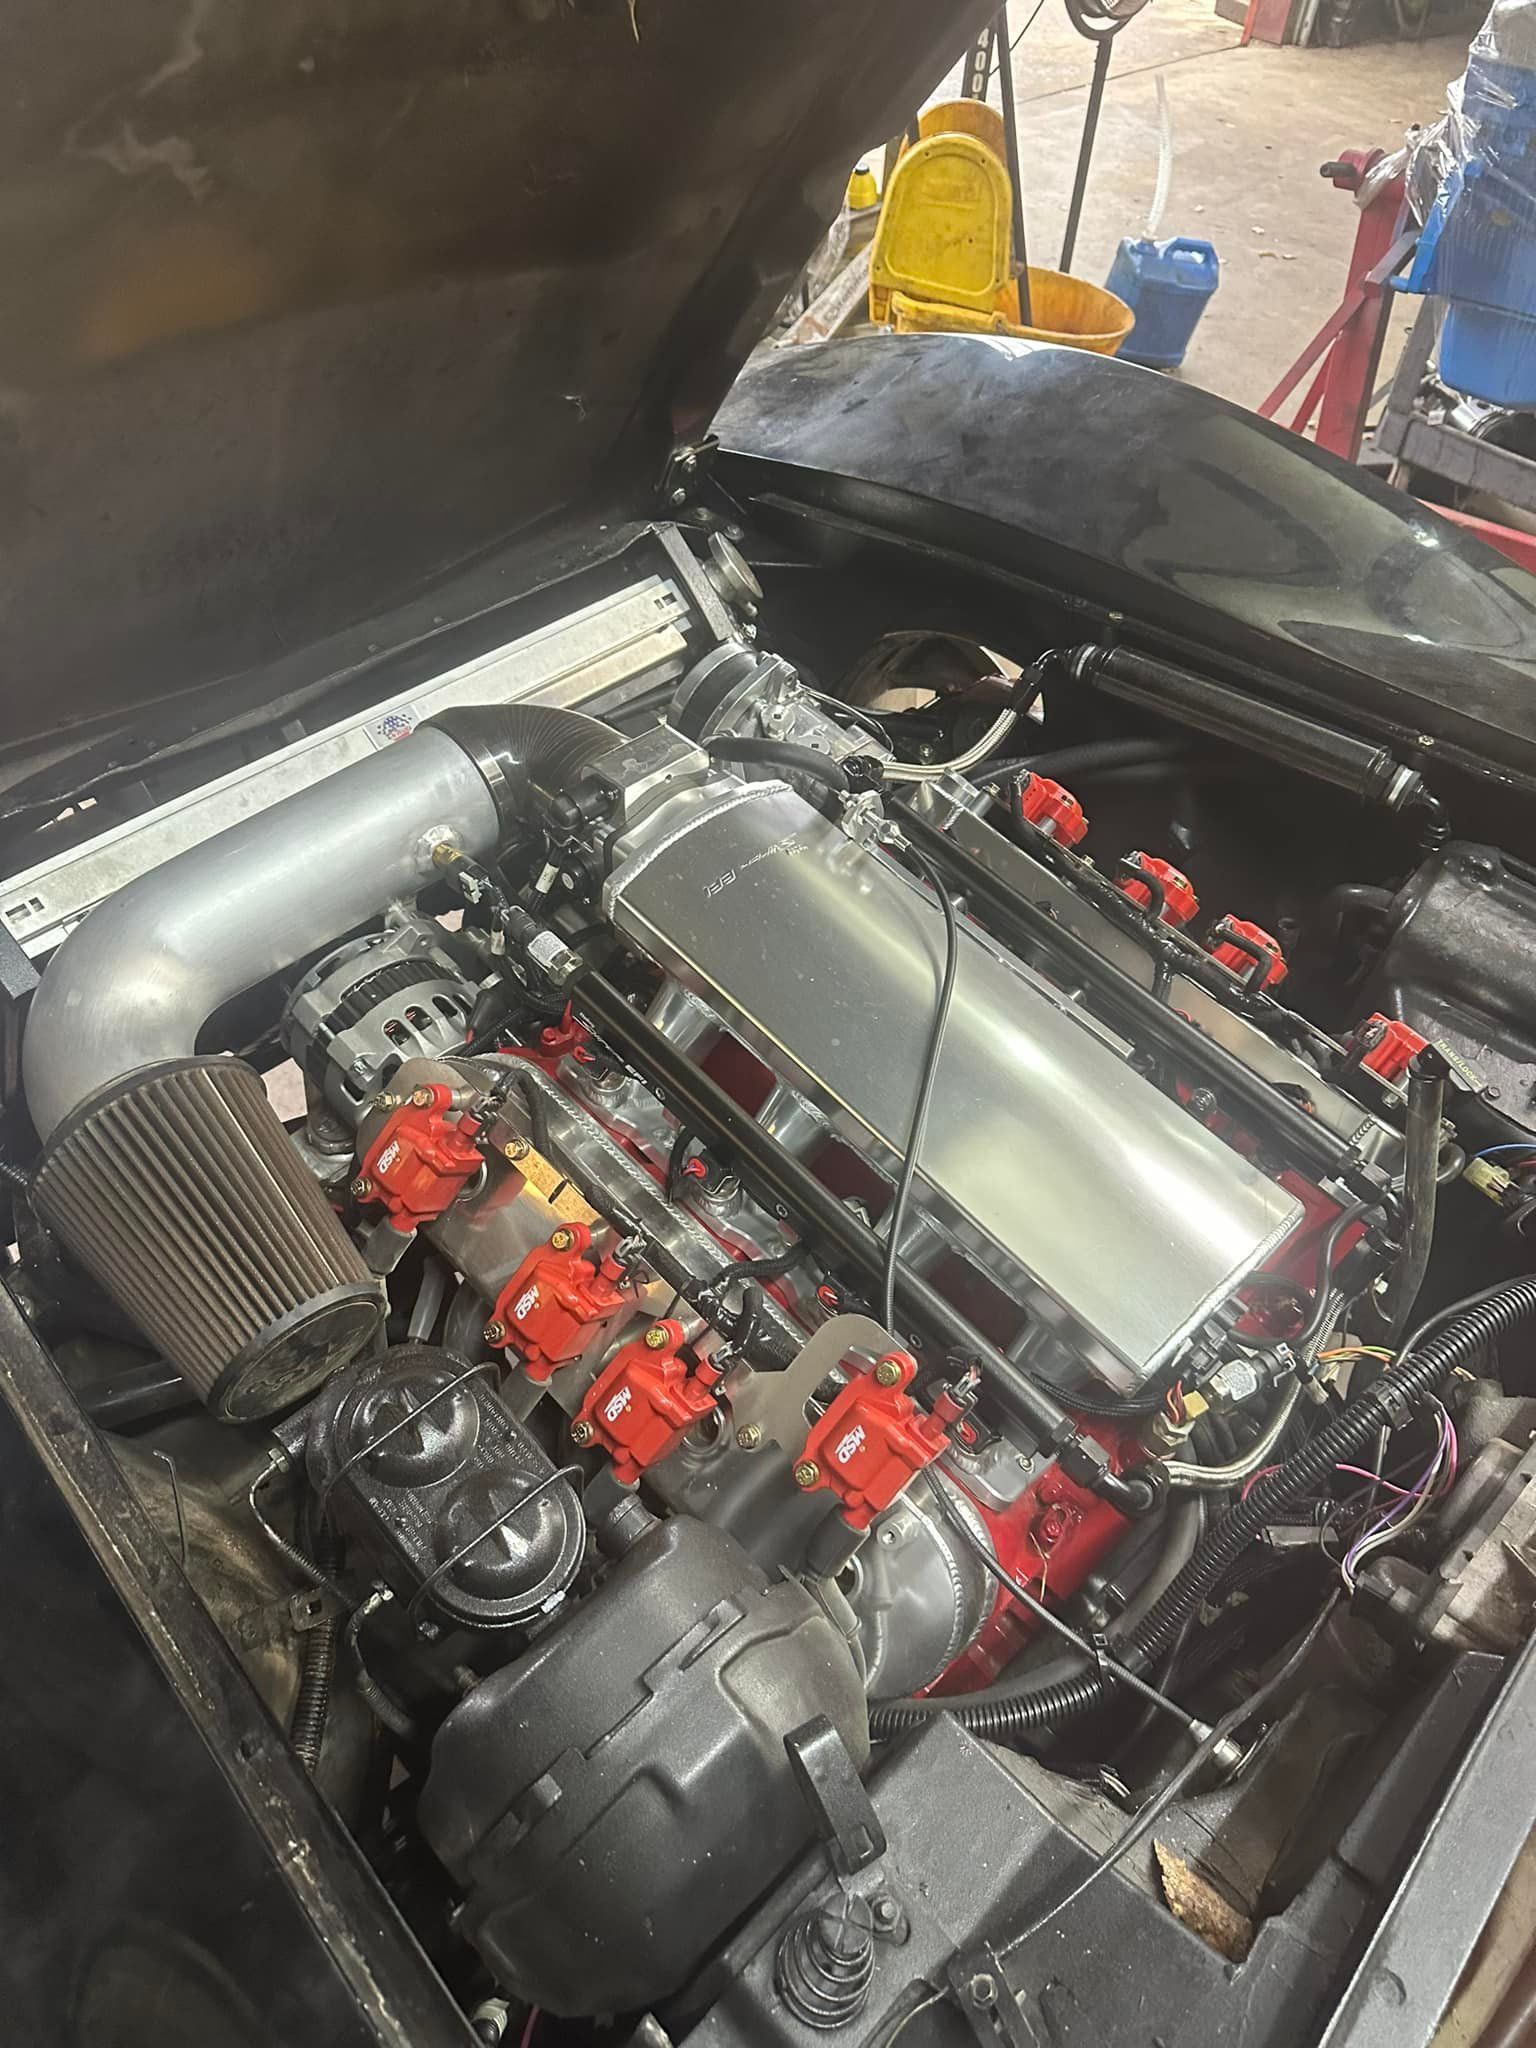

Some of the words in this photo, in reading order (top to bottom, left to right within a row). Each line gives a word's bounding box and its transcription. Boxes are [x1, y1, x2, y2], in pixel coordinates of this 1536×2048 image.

[971, 27, 990, 100] 400
[703, 868, 736, 898] EFI
[377, 1140, 400, 1174] MSD
[514, 1284, 540, 1320] MSD
[604, 1386, 632, 1422] MSD
[834, 1424, 866, 1464] MSD
